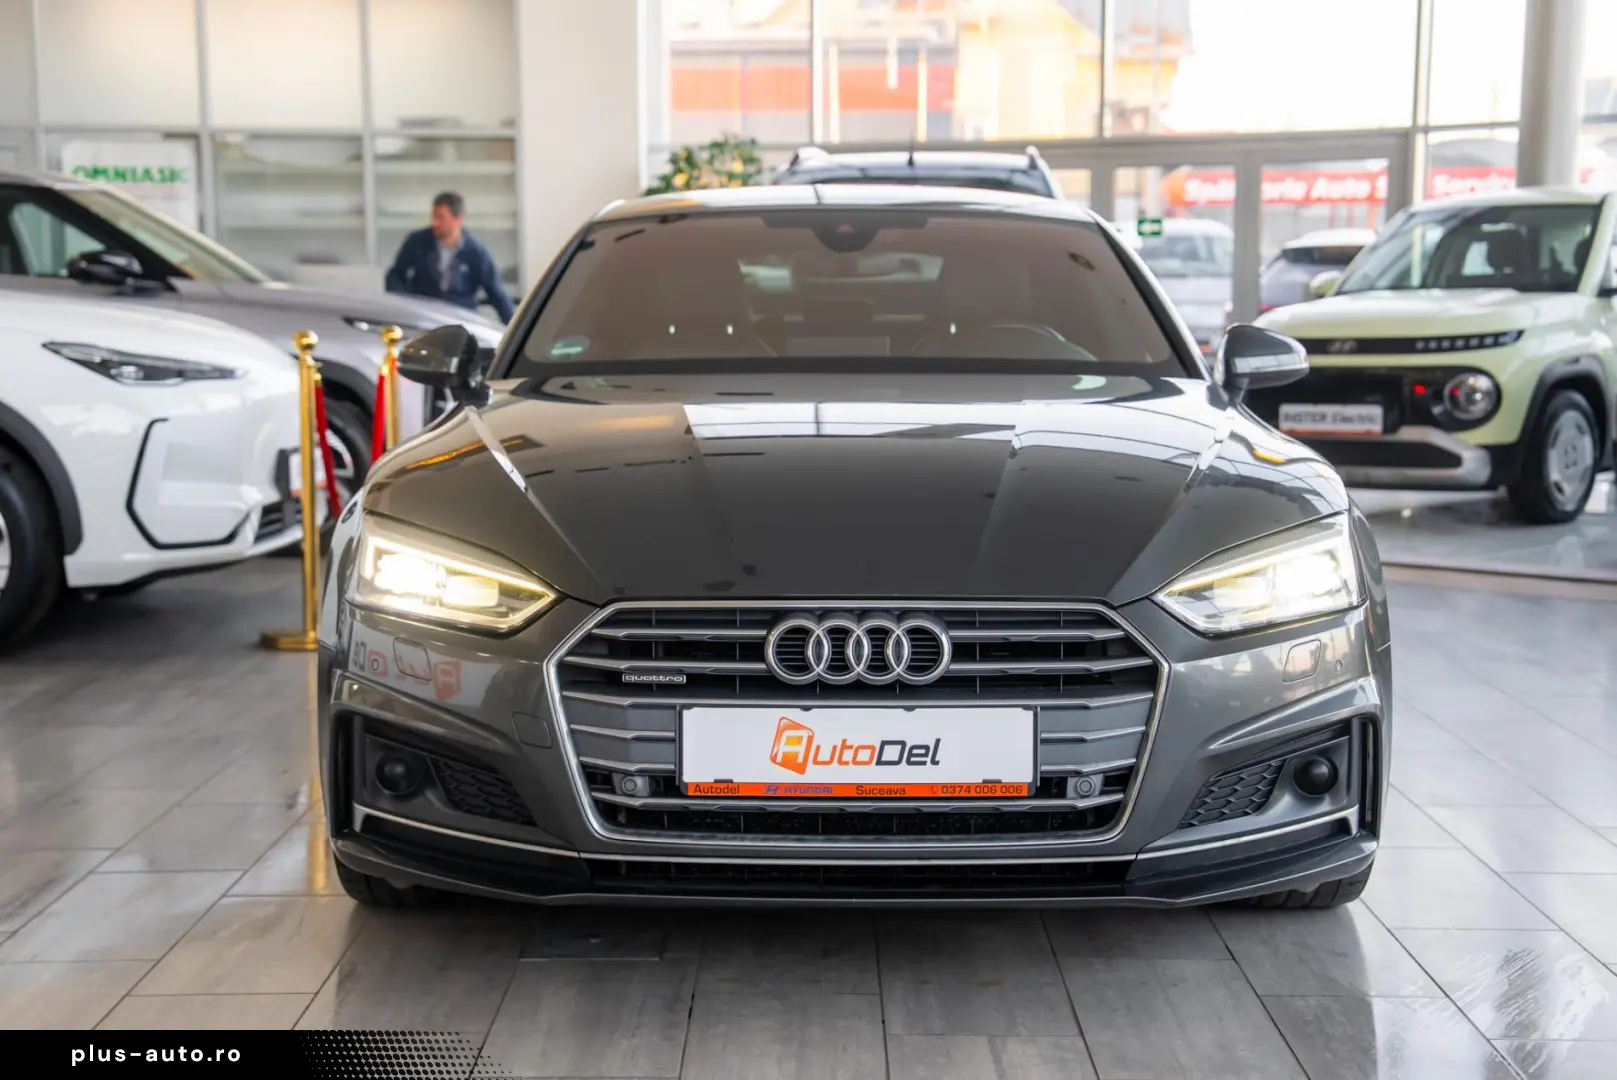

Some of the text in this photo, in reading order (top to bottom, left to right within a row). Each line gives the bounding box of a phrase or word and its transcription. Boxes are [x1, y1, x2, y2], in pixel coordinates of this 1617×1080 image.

[624, 674, 684, 683] quattro
[771, 718, 942, 774] AutoDel
[693, 784, 1023, 796] Autodel HYUNDAI Suceava 0374 006 006
